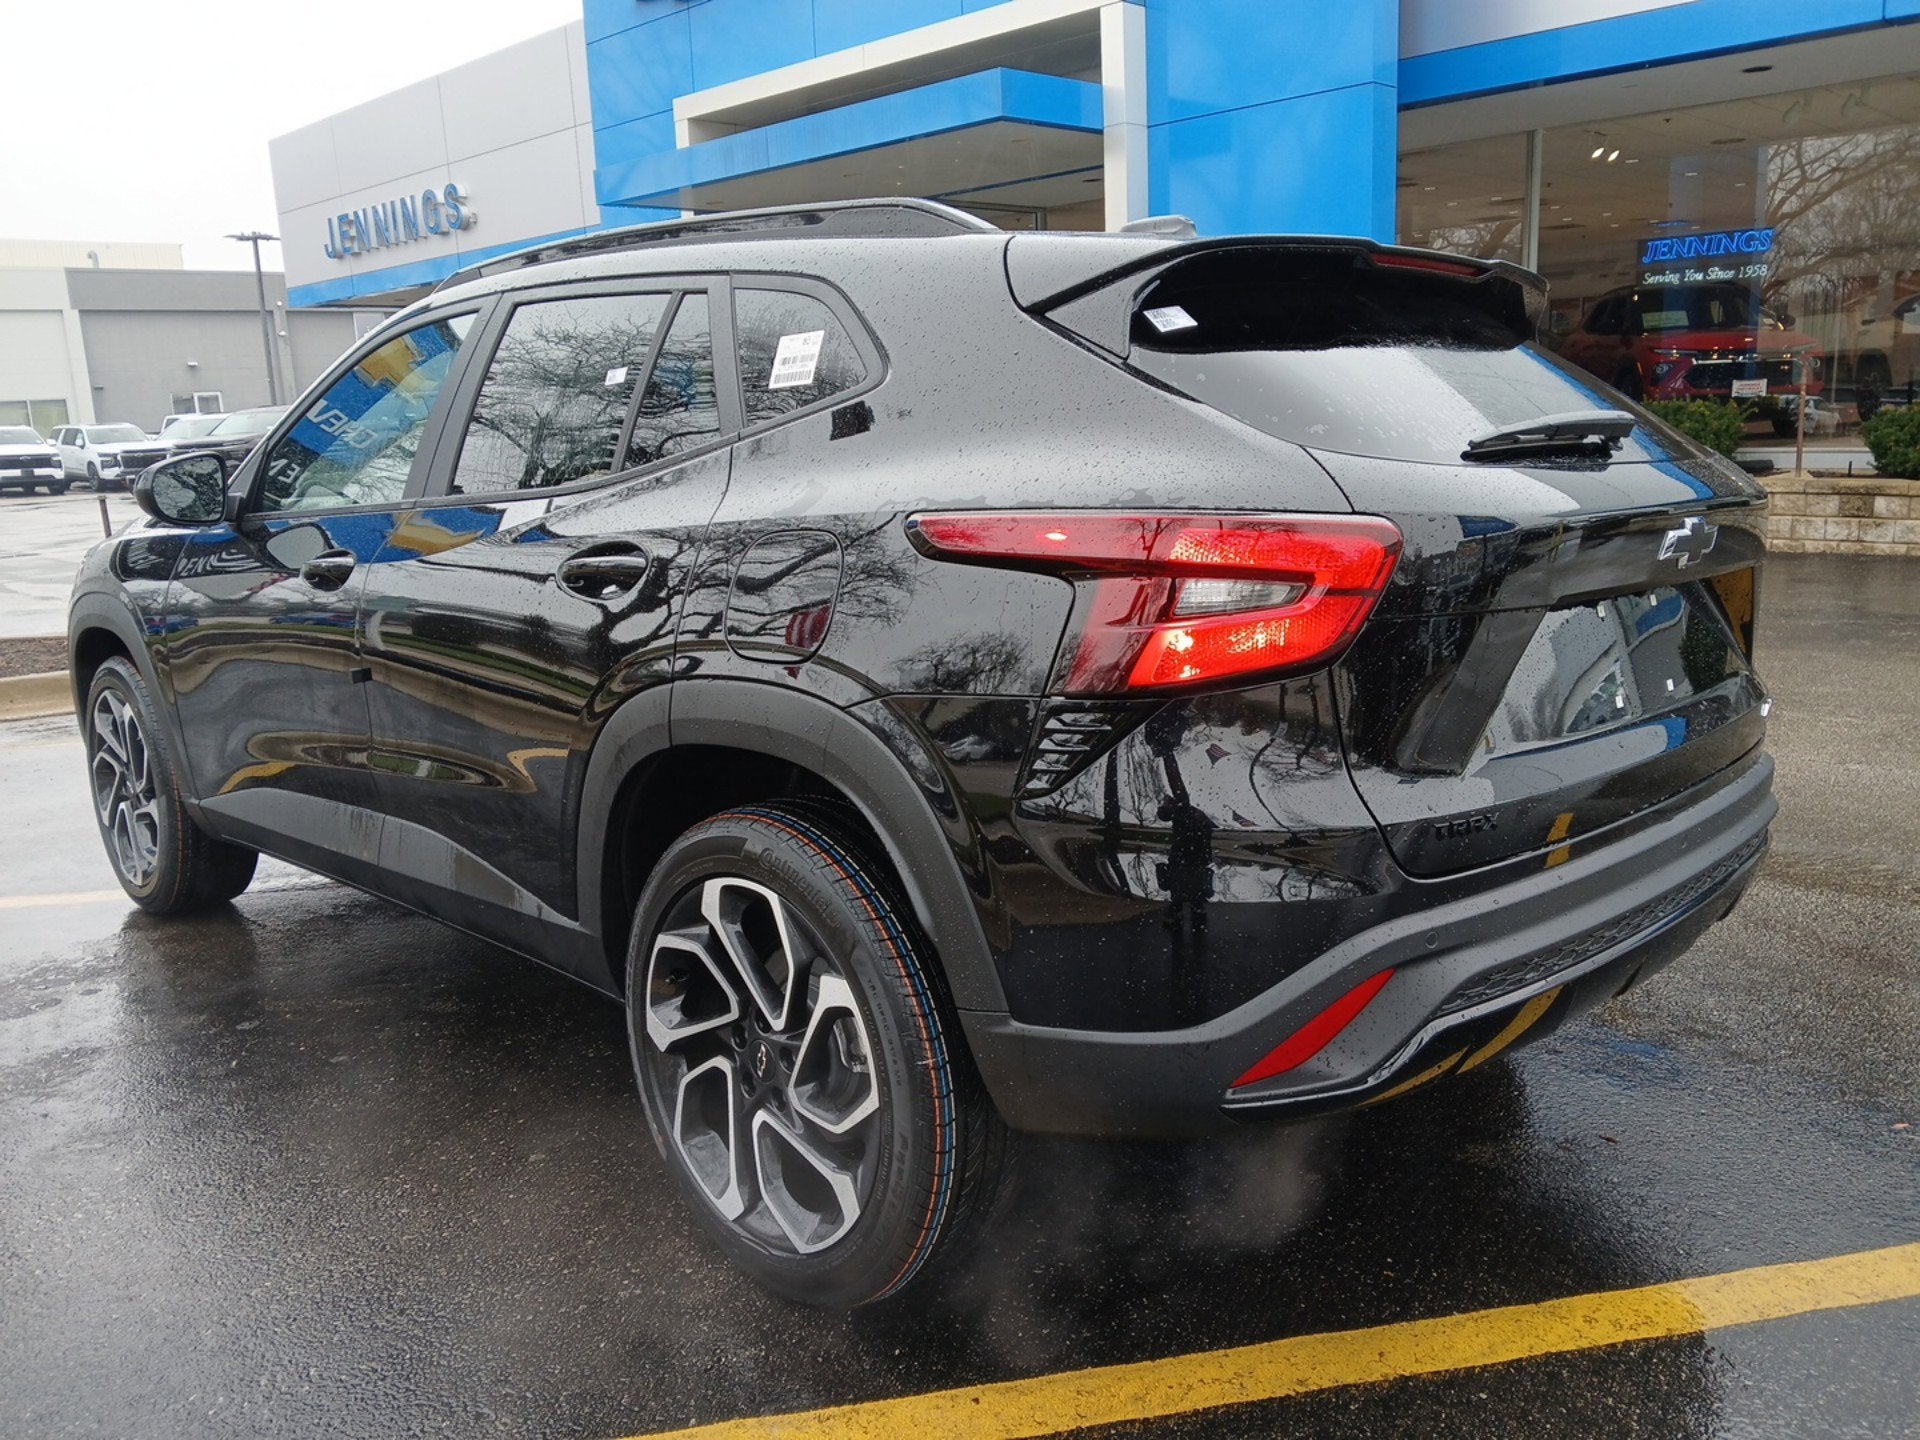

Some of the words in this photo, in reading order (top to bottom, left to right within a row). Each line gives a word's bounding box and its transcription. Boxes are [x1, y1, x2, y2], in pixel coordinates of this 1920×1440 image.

[324, 183, 467, 260] JENNINGS
[1642, 229, 1774, 263] JENNINGS
[1643, 271, 1680, 285] Serving
[1684, 269, 1704, 281] You
[1706, 266, 1735, 280] Since
[1738, 264, 1768, 278] 1958
[1433, 812, 1500, 841] TRAX
